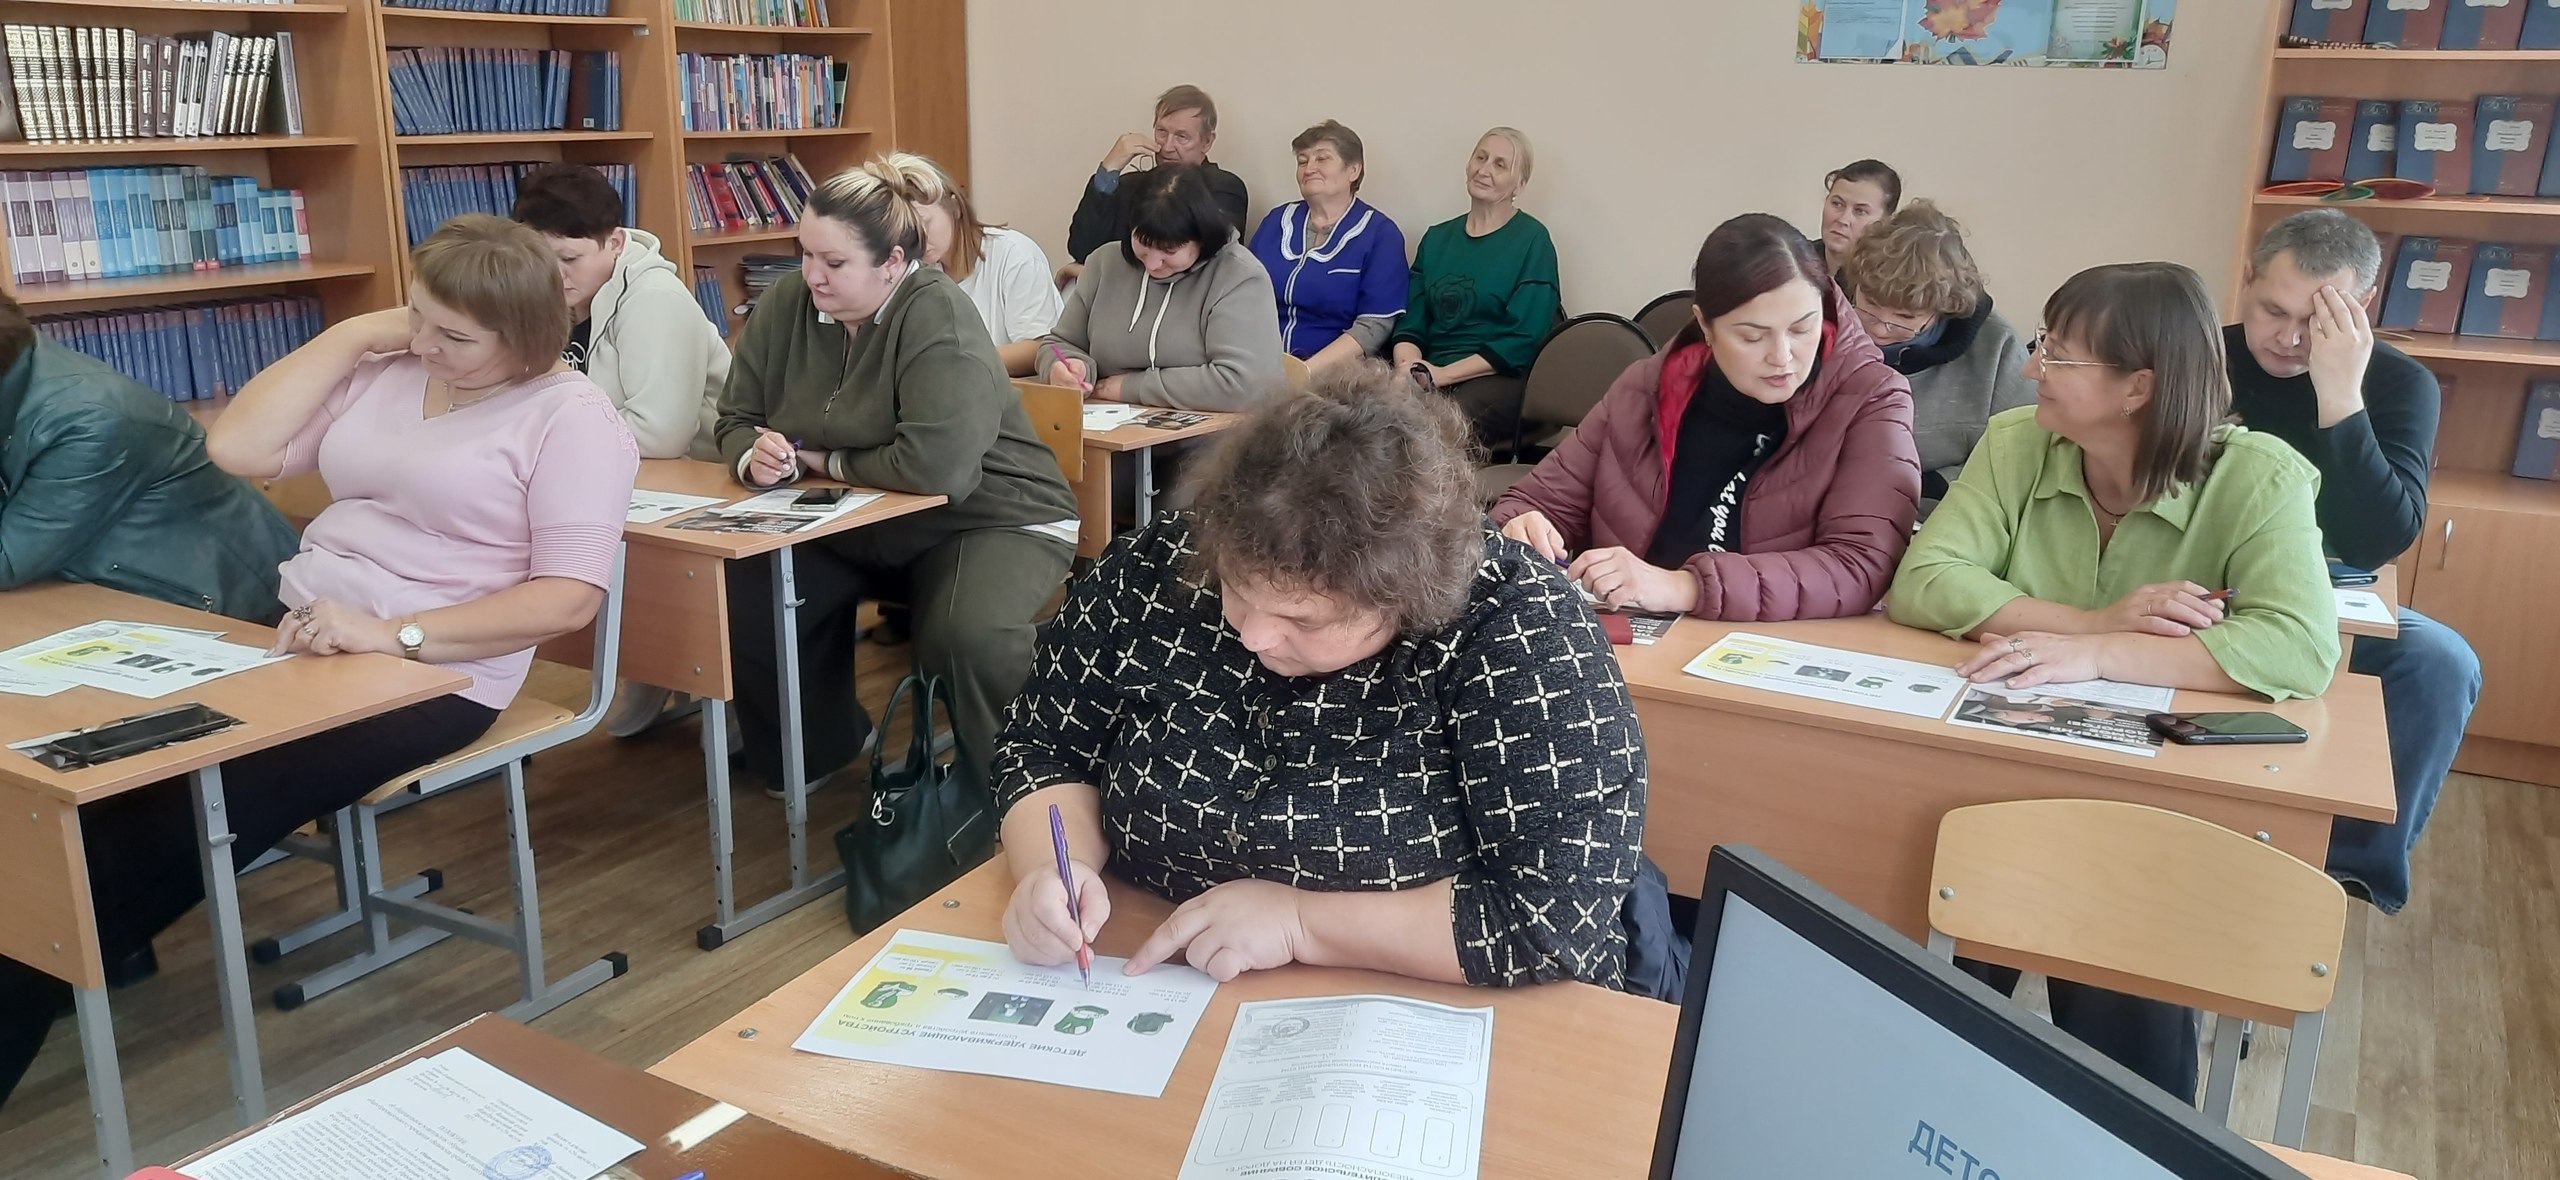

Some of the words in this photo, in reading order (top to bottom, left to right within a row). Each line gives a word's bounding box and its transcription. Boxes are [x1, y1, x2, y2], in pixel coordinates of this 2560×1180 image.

[837, 1019, 916, 1037] УСТРОЙСТВА
[919, 1031, 1027, 1049] УДЕРЖИВАЮЩИЕ
[1028, 1043, 1087, 1057] ДЕТСКИЕ
[1239, 1165, 1302, 1176] СОБРАНИЕ
[1304, 1166, 1389, 1180] ДИТЕЛЬСКОЕ
